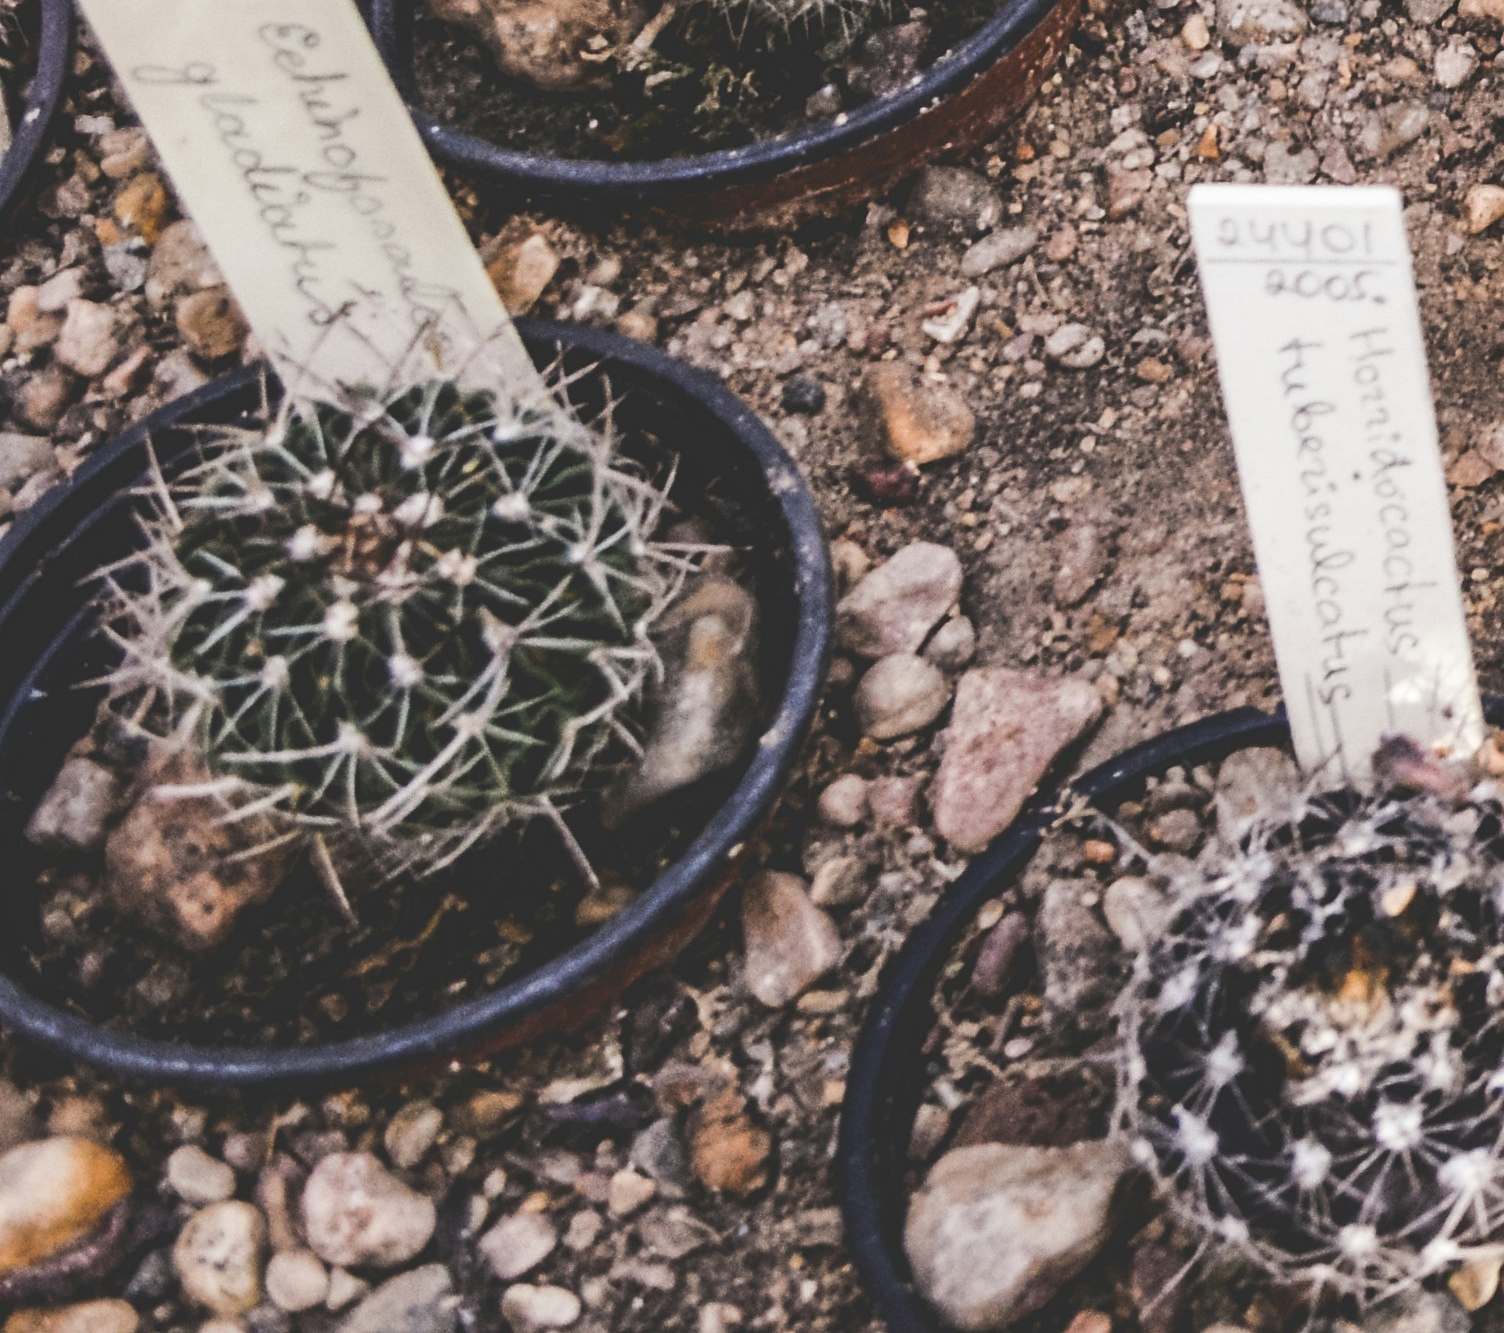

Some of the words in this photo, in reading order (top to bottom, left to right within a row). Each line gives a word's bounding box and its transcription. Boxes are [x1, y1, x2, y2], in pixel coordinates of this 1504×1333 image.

[1214, 217, 1374, 262] 24401
[1271, 335, 1359, 706] tuberisulcatus
[1343, 323, 1438, 660] Horridocactus
